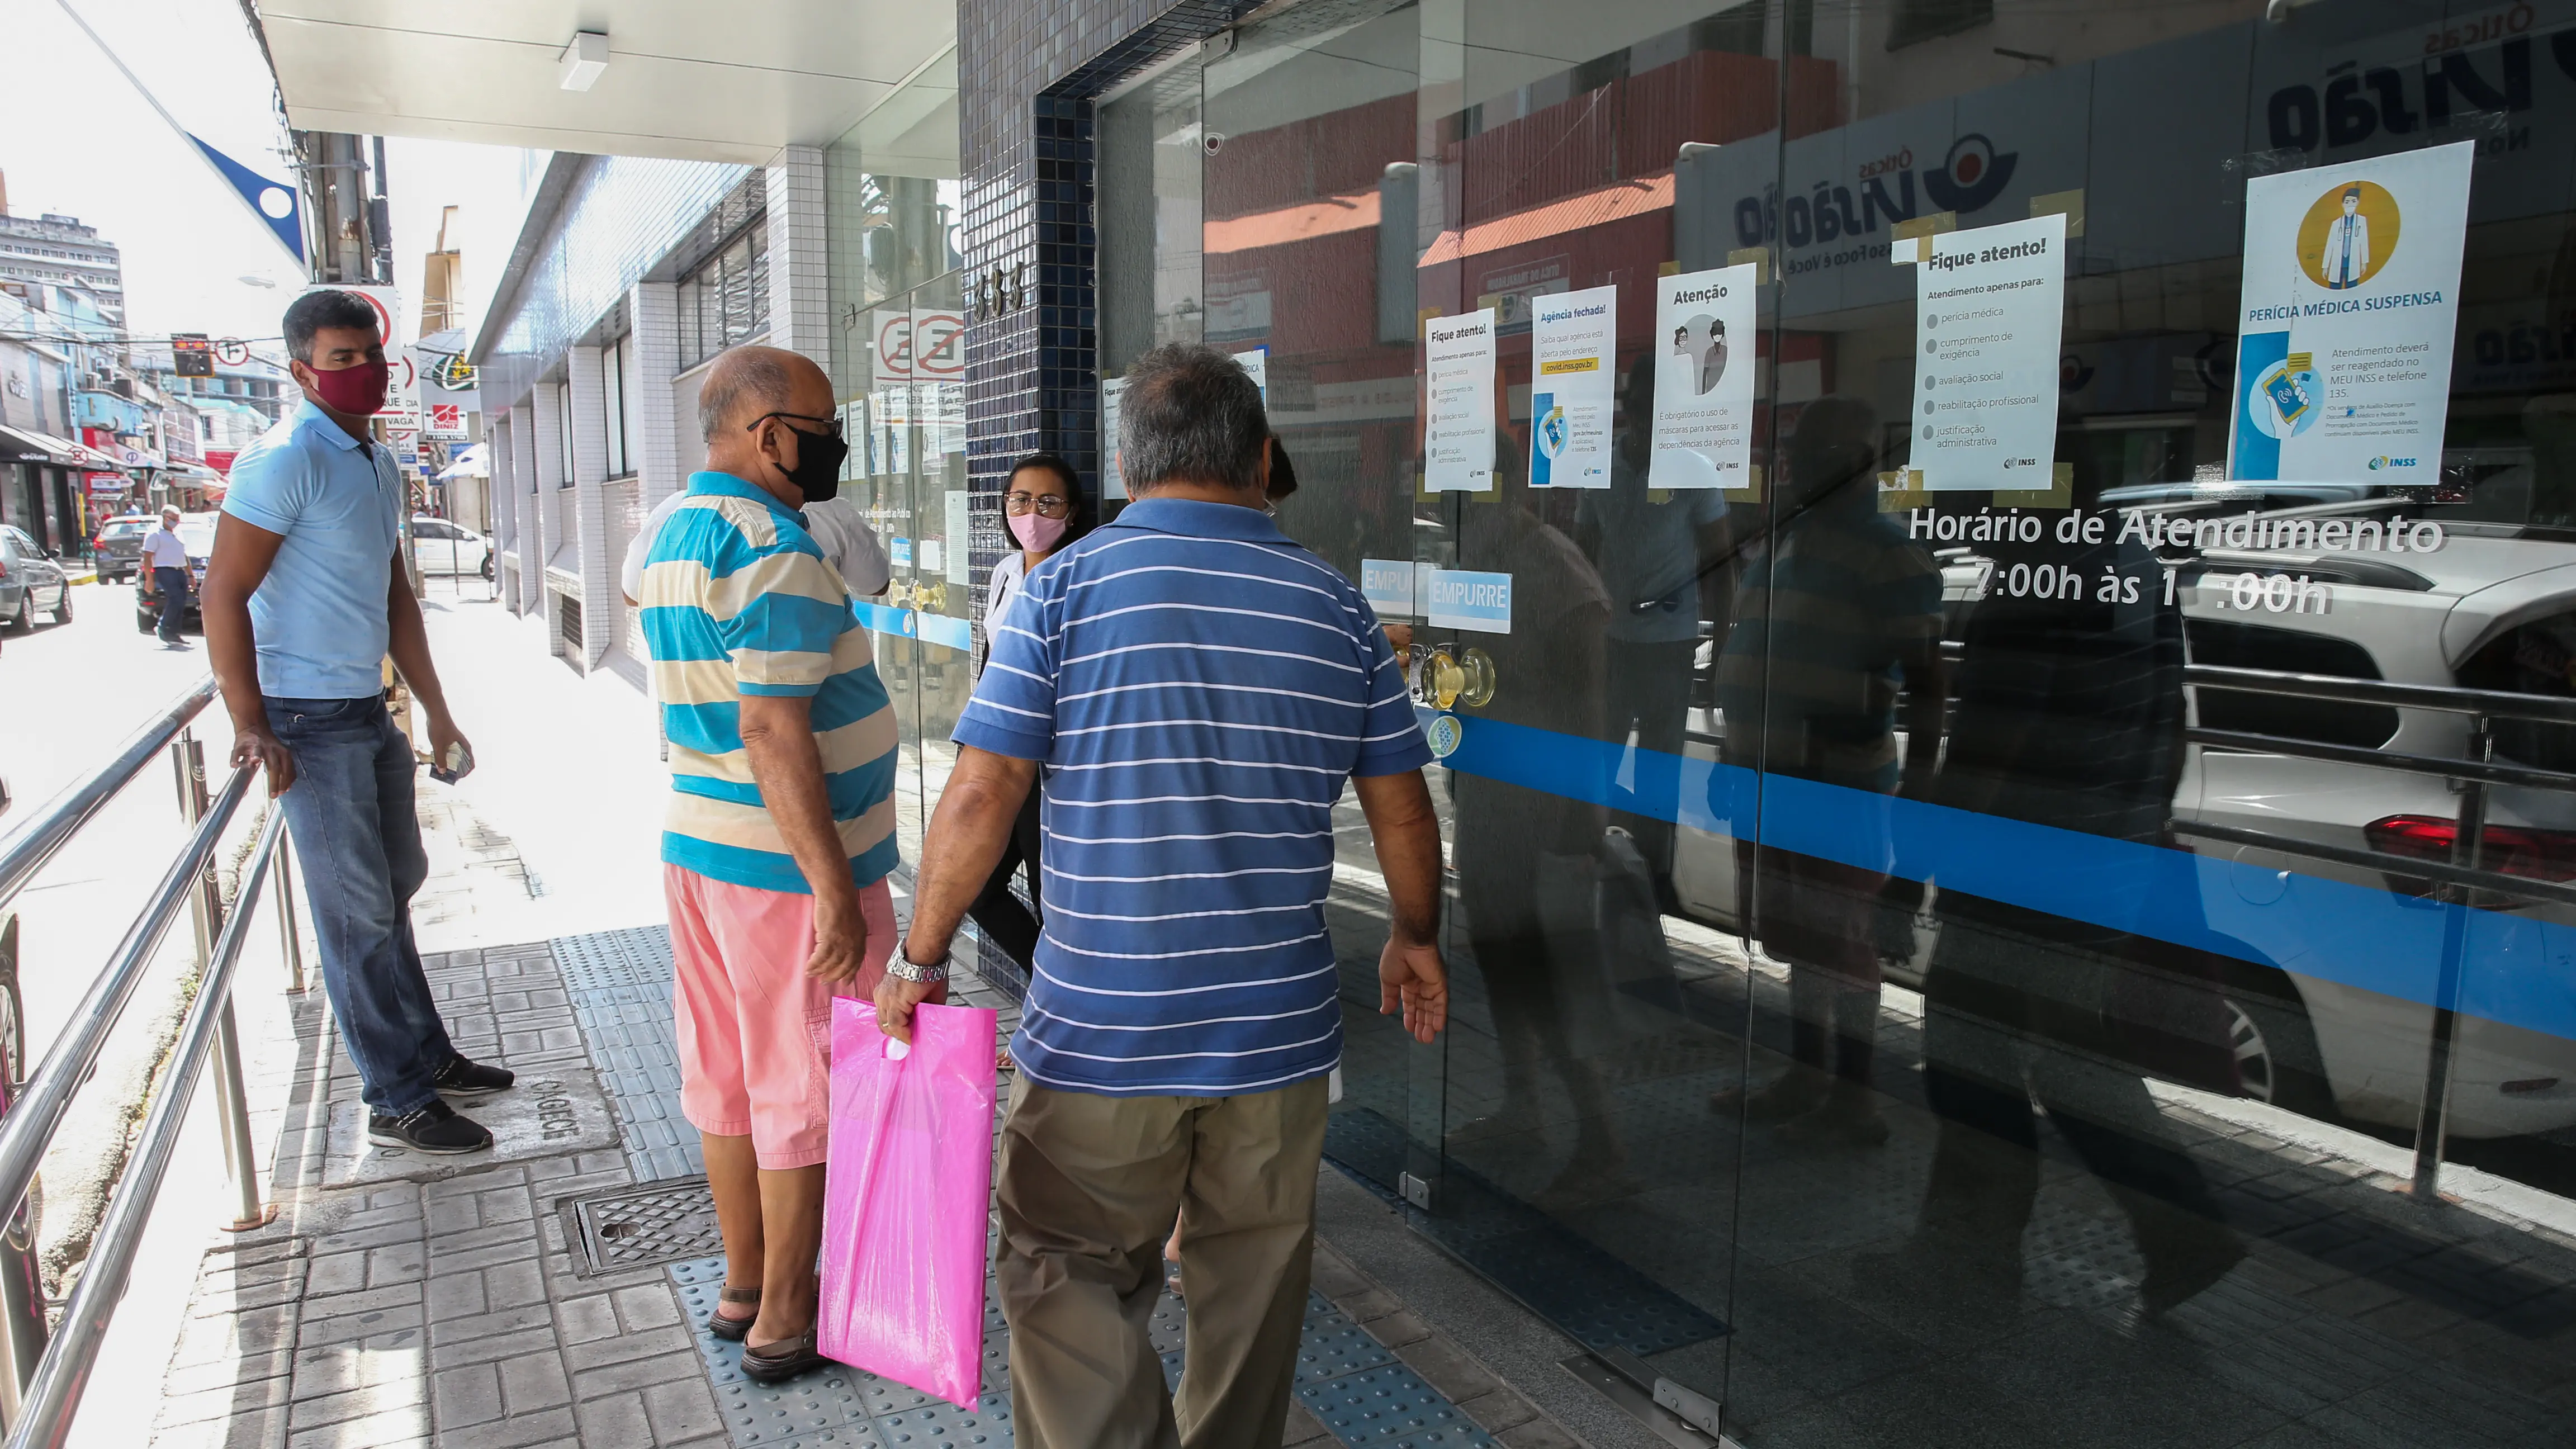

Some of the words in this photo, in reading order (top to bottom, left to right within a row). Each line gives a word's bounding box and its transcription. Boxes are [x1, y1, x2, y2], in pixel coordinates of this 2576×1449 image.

[1929, 252, 1975, 271] Fique
[1981, 238, 2047, 263] atento!
[973, 262, 1024, 321] 383
[1673, 284, 1728, 305] Atenção
[1928, 286, 1984, 300] Atendimento
[1986, 281, 2019, 293] apenas
[2021, 278, 2044, 289] para:
[1541, 309, 1572, 323] Agência
[1574, 304, 1606, 318] fechada!
[2249, 304, 2300, 321] PERÍCIA
[2303, 300, 2360, 317] MÉDICA
[2364, 291, 2442, 310] SUSPENSA
[1942, 311, 1969, 324] perícia
[1972, 307, 2004, 319] médica
[1432, 330, 1454, 343] Fique
[1456, 323, 1486, 338] atento!
[1557, 333, 1569, 344] qual
[1570, 331, 1590, 342] agência
[1592, 329, 1603, 338] está
[1940, 334, 1999, 347] cumprimento
[2001, 332, 2012, 340] de
[1560, 348, 1571, 357] pelo
[1940, 348, 1980, 361] exigência
[2332, 344, 2393, 358] Atendimento
[2396, 342, 2429, 353] deverá
[1431, 354, 1458, 362] Atendimento
[1546, 360, 1593, 371] covid.inss.gov.br
[2331, 363, 2345, 372] ser
[2348, 358, 2404, 372] reagendado
[2407, 358, 2419, 366] no
[1939, 373, 1978, 385] avaliação
[1980, 371, 2004, 382] social
[2330, 375, 2352, 385] MEU
[2356, 373, 2376, 383] INSS
[2387, 370, 2427, 381] telefone
[2329, 389, 2349, 399] 135.
[1938, 399, 1987, 410] reabilitação
[1989, 394, 2039, 408] profissional
[1665, 410, 1699, 420] obrigatório
[1659, 426, 1689, 434] máscaras
[1936, 424, 1985, 437] justificação
[1658, 439, 1703, 451] dependências
[1713, 437, 1740, 448] agência
[1936, 437, 1997, 448] administrativa
[2389, 458, 2416, 467] INSS
[1910, 507, 2043, 544] Horário
[2057, 509, 2104, 544] de
[2116, 509, 2444, 553] Atendimento
[1975, 562, 2082, 602] 7:00h
[2097, 566, 2141, 605] às
[1433, 582, 1507, 608] EMPURRE
